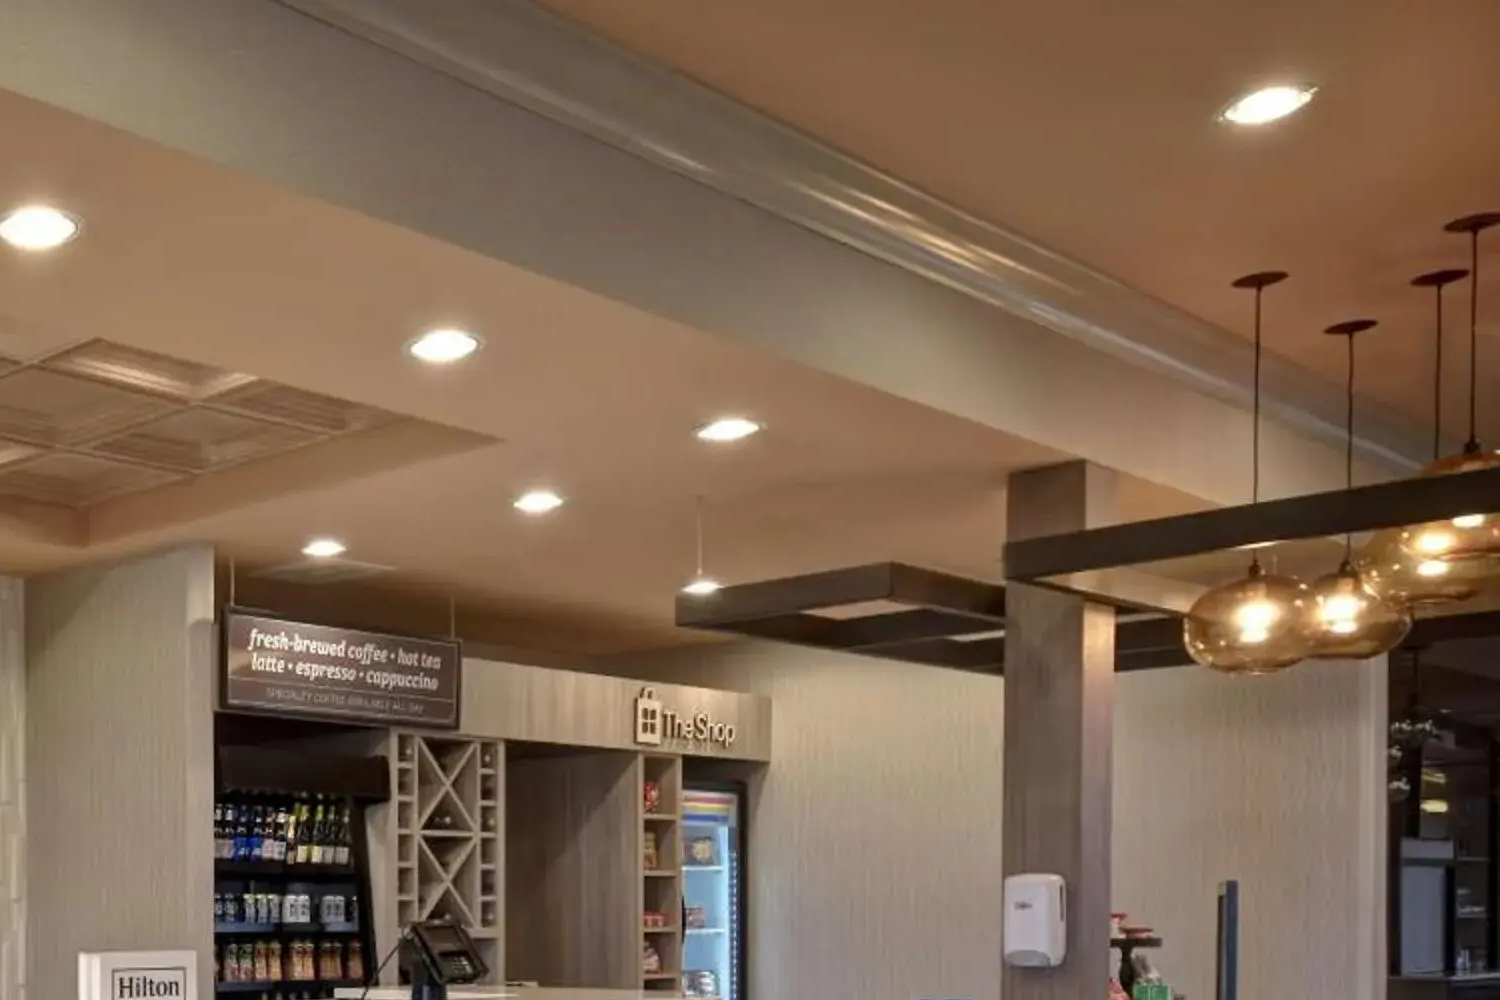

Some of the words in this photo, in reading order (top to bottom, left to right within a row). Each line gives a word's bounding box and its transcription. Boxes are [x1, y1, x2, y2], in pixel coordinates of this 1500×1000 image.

[248, 629, 345, 657] fresh-brewed
[348, 642, 387, 665] coffee
[397, 647, 419, 665] hot
[421, 653, 441, 670] tea
[251, 653, 285, 673] latte
[295, 660, 357, 682] espresso
[365, 669, 439, 691] cappuccino
[663, 708, 694, 738] The
[694, 712, 736, 748] Shop
[118, 976, 180, 998] Hilton
